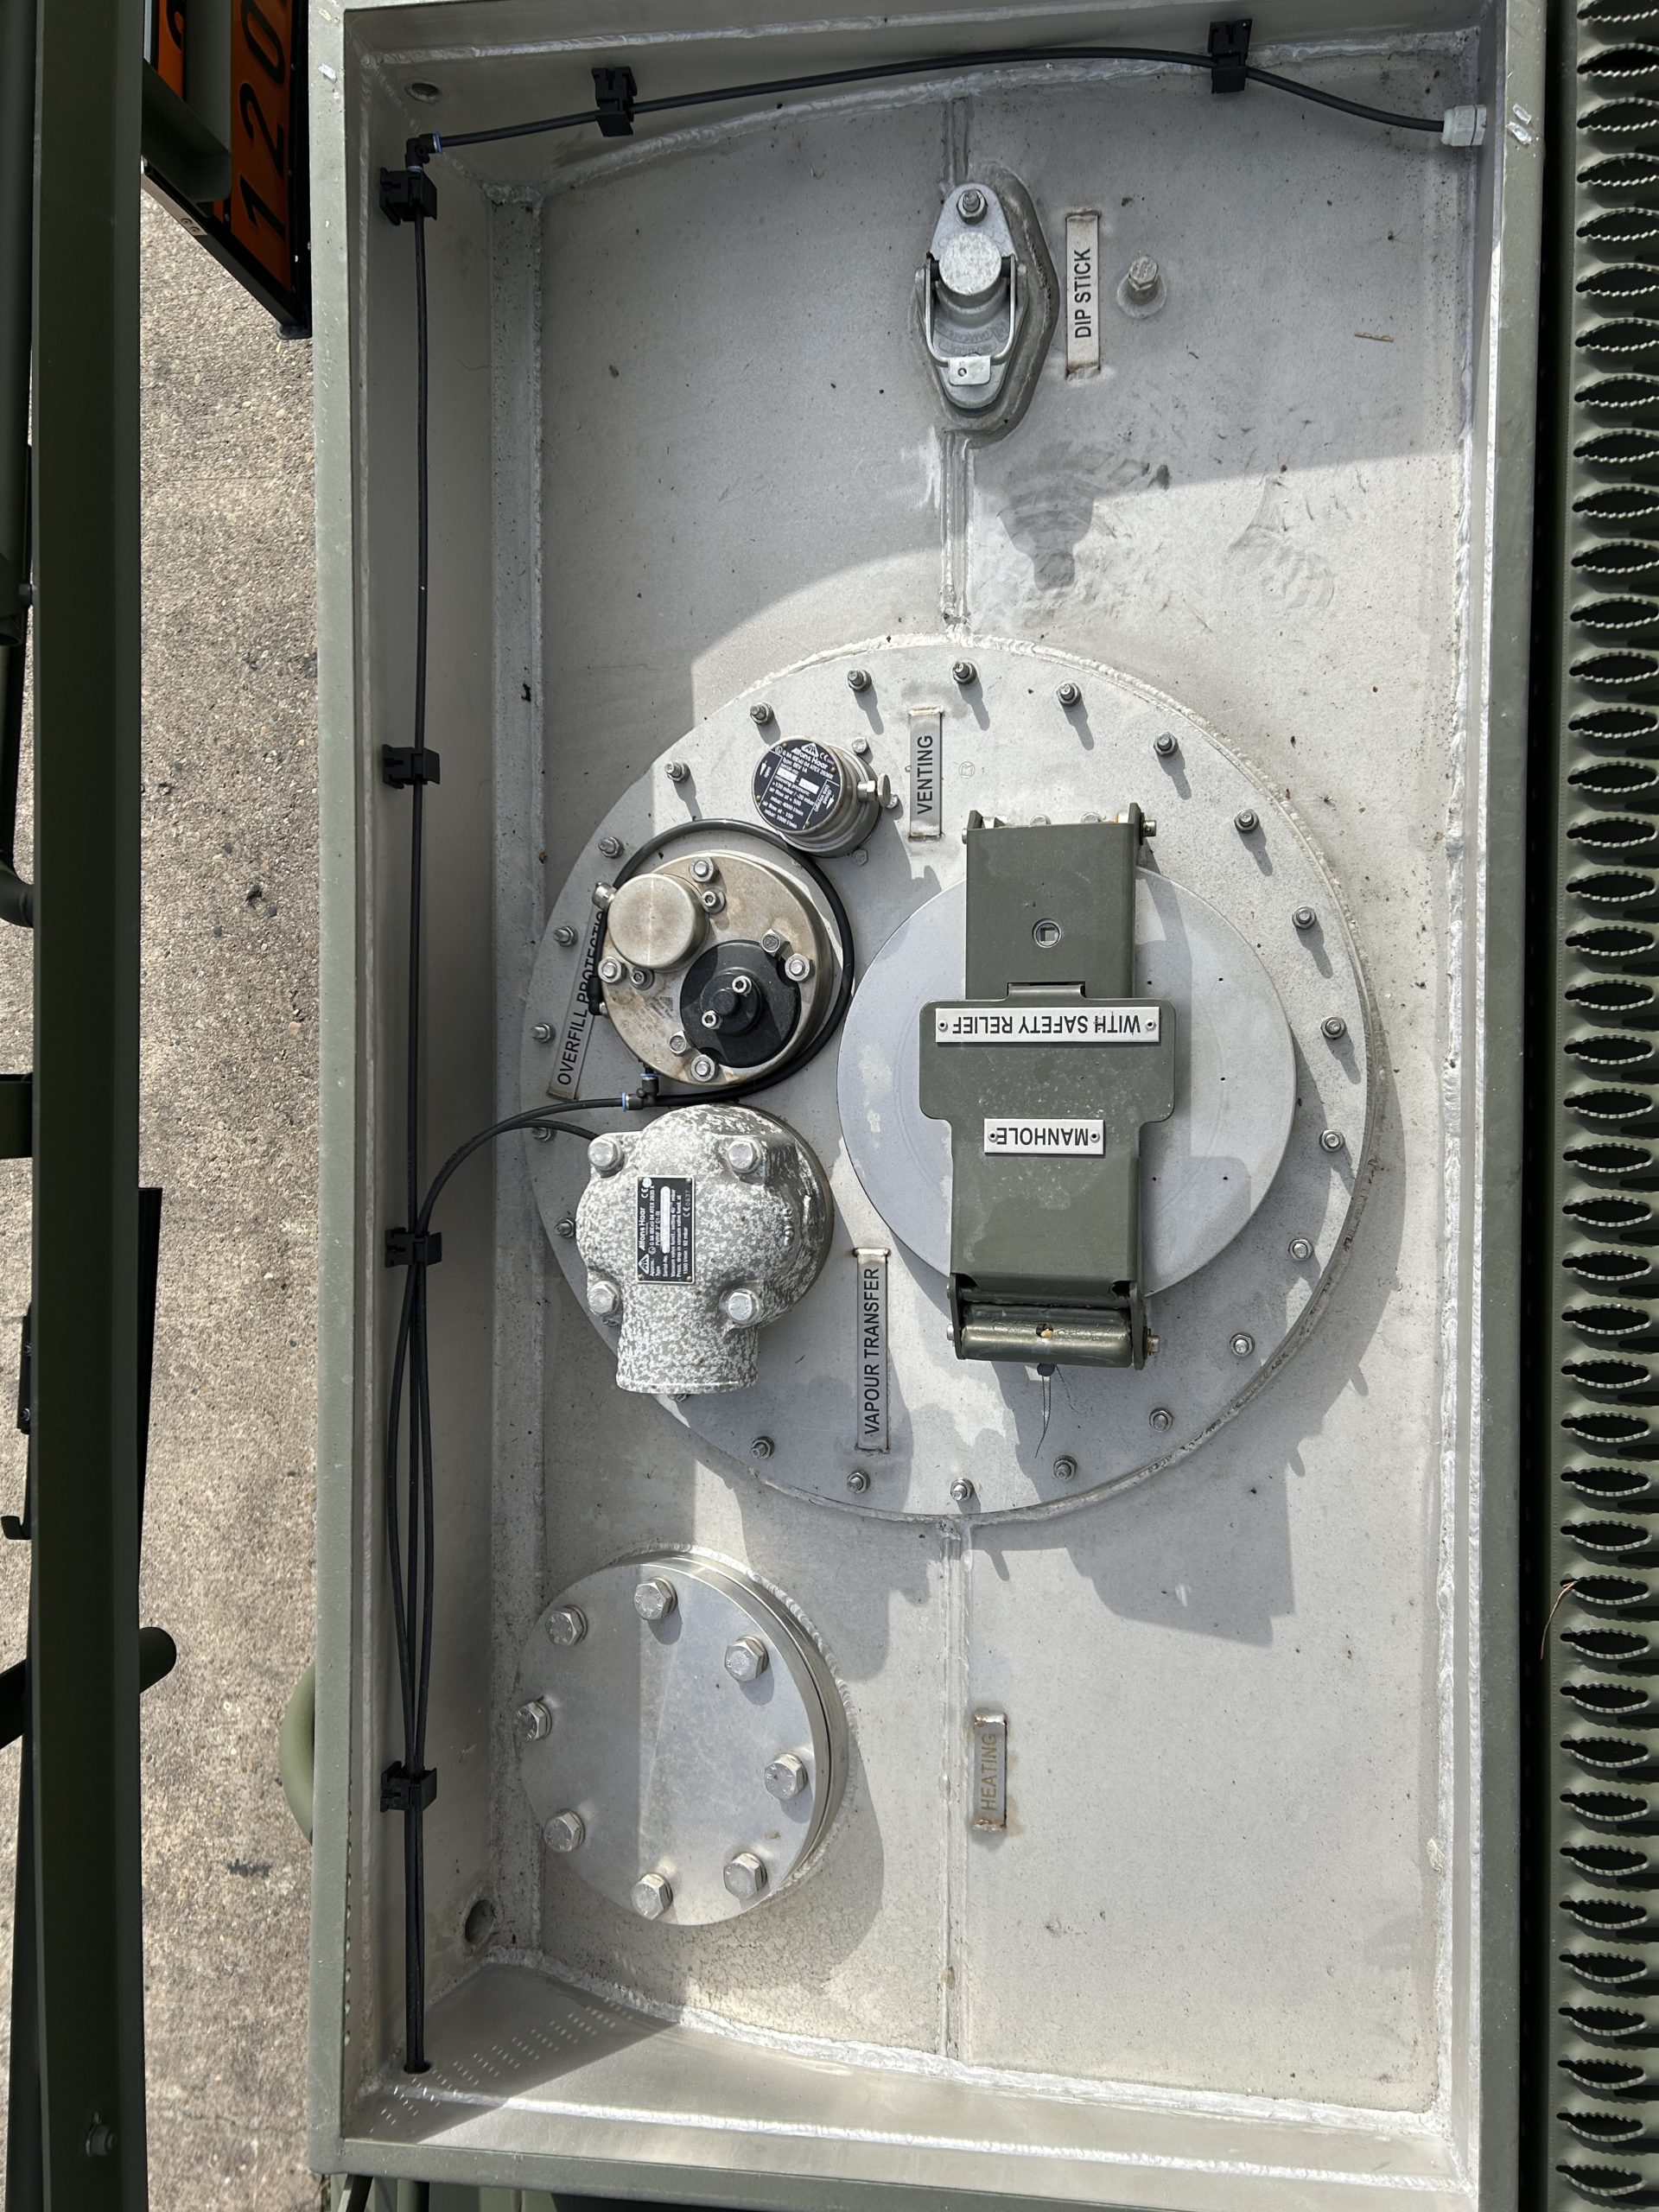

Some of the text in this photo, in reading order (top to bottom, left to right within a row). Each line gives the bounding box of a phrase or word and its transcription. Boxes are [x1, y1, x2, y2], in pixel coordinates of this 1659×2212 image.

[238, 0, 286, 242] 120
[1075, 309, 1091, 338] DIP
[791, 747, 829, 770] Alfons Haar
[918, 735, 932, 814] VENTING
[556, 1009, 588, 1085] OVERFILL
[952, 1015, 1141, 1033] WITH SAFETY RELIEF
[996, 1127, 1089, 1146] MANHOLE
[864, 1268, 880, 1434] VAPOUR TRANSFER
[981, 1732, 997, 1810] HEATING
